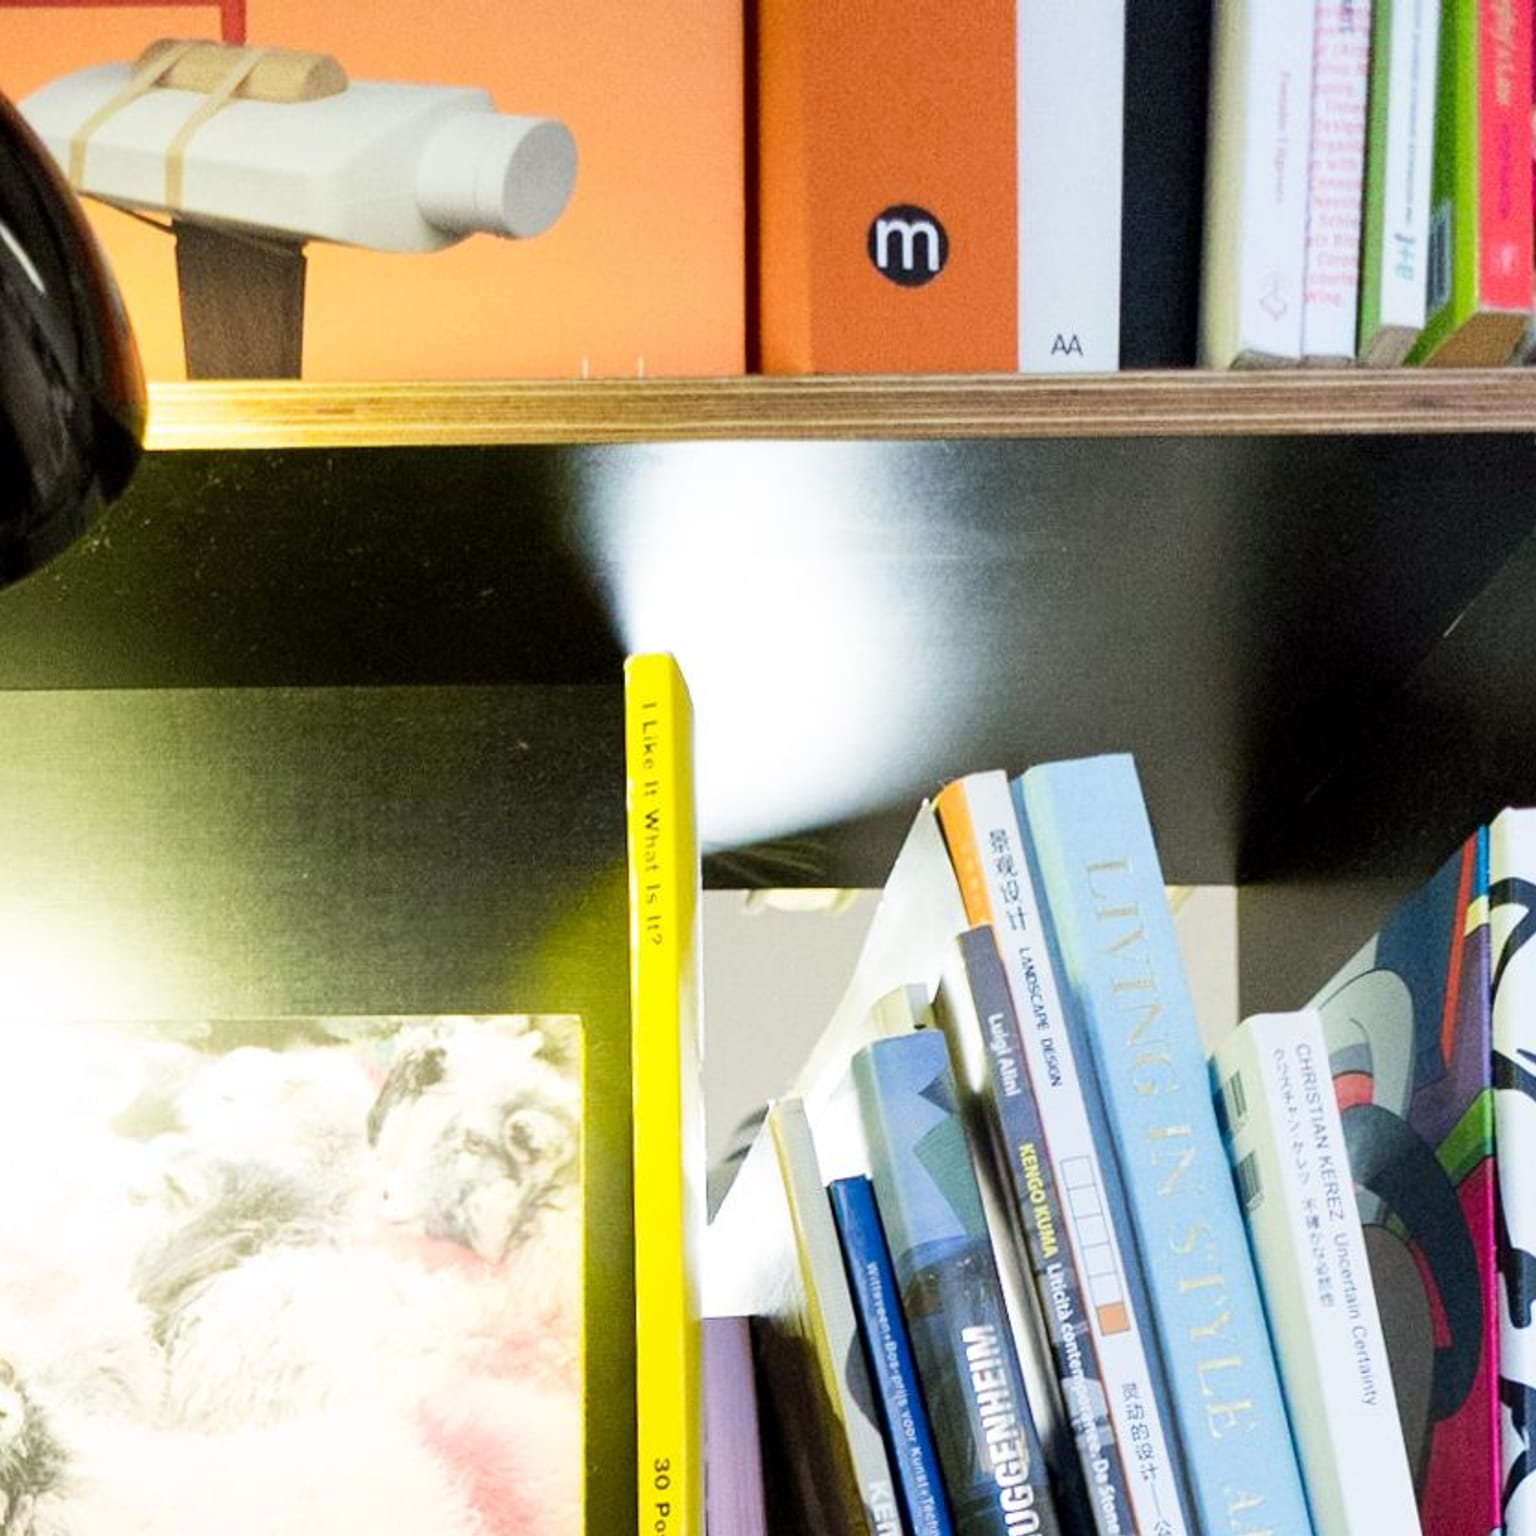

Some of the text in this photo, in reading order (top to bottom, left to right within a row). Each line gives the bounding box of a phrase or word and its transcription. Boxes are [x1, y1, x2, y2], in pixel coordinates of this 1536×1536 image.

[1051, 334, 1084, 357] AA
[641, 720, 659, 770] Like
[644, 781, 659, 804] It
[644, 810, 662, 869] What
[646, 876, 661, 904] Is
[989, 827, 1028, 932] 景观设计
[648, 917, 664, 947] It?
[1084, 856, 1180, 1098] LIVING
[1018, 946, 1064, 1088] LANDSCAPE DESIGN
[987, 1012, 1021, 1098] Luigi Alini
[1018, 1142, 1044, 1205] KENGO
[1144, 1123, 1197, 1198] IN
[1035, 1206, 1059, 1260] KUMA
[1294, 1042, 1330, 1151] CHRISTIAN
[1319, 1153, 1345, 1223] KEREZ
[1334, 1231, 1362, 1321] Uncertain
[1350, 1324, 1380, 1408] Certainty
[1168, 1219, 1258, 1441] STYLE
[900, 1411, 920, 1445] voor
[653, 1458, 670, 1490] 30
[1095, 1457, 1112, 1483] Da
[1101, 1483, 1121, 1532] Stone
